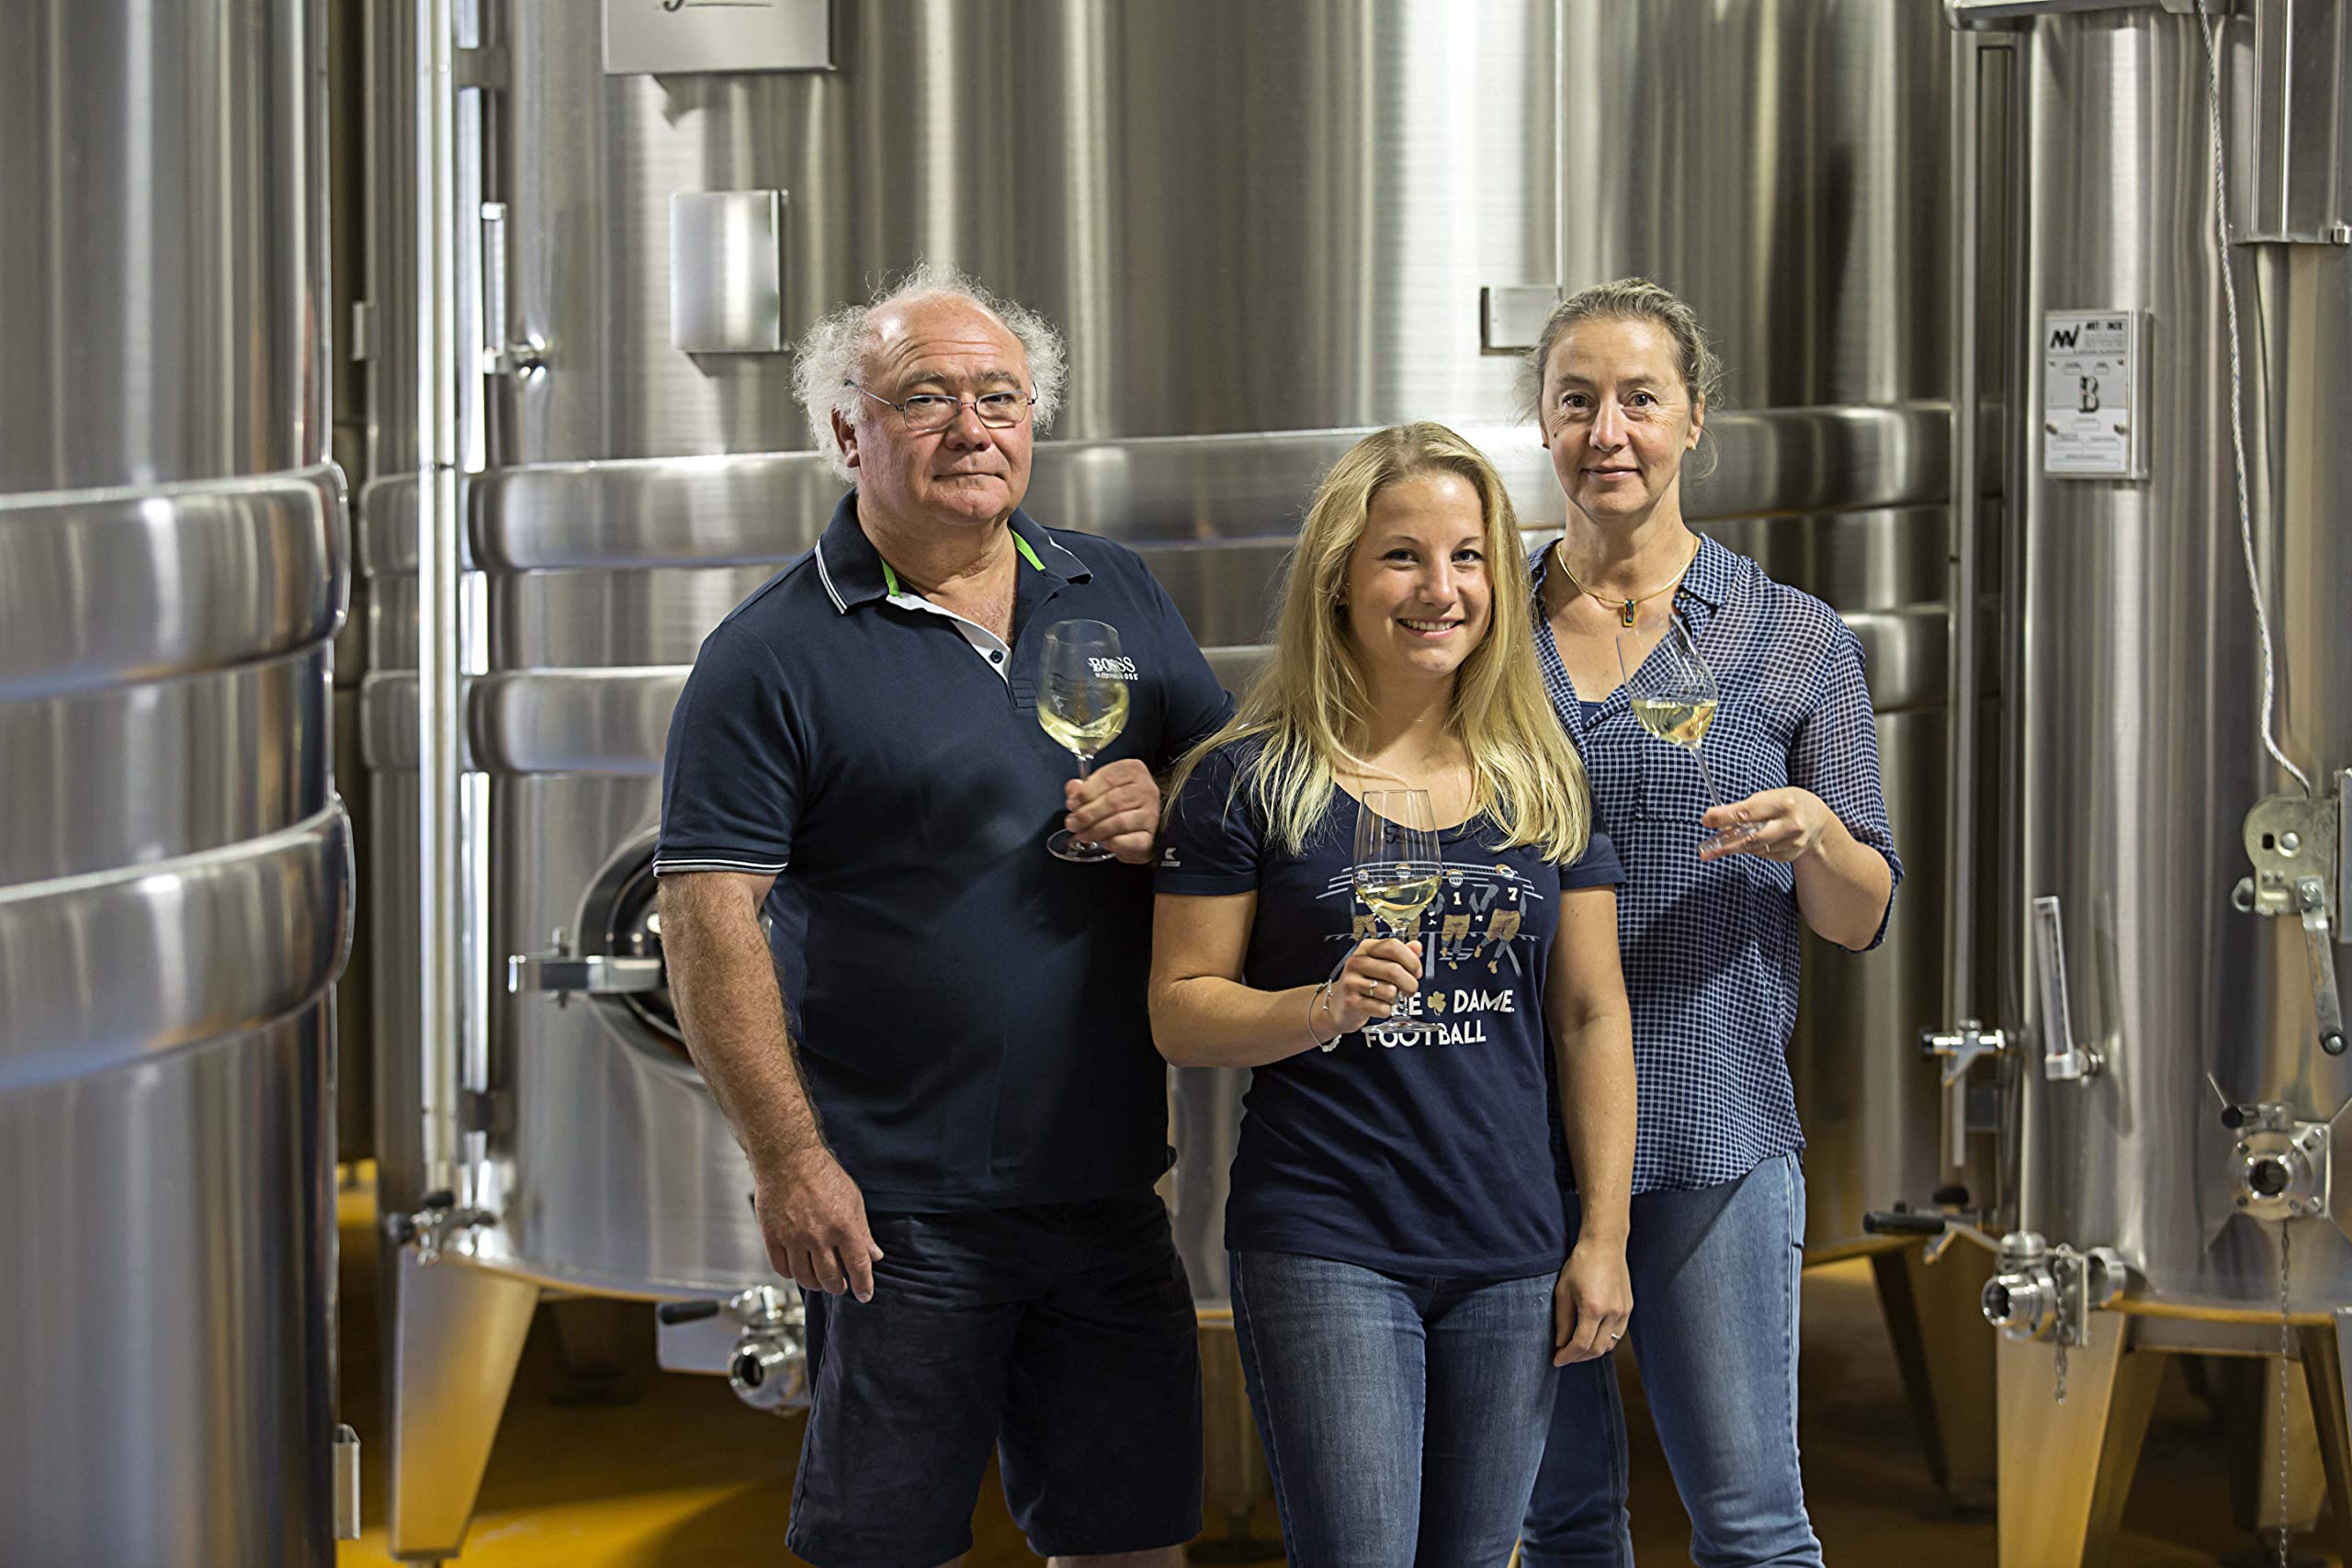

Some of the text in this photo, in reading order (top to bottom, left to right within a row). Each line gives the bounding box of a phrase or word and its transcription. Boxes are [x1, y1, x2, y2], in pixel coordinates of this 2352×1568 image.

[2078, 375, 2100, 413] B
[1088, 657, 1136, 673] BOSS
[1453, 892, 1462, 905] 1
[1508, 887, 1518, 901] 7
[1365, 1020, 1487, 1048] FOOTBALL
